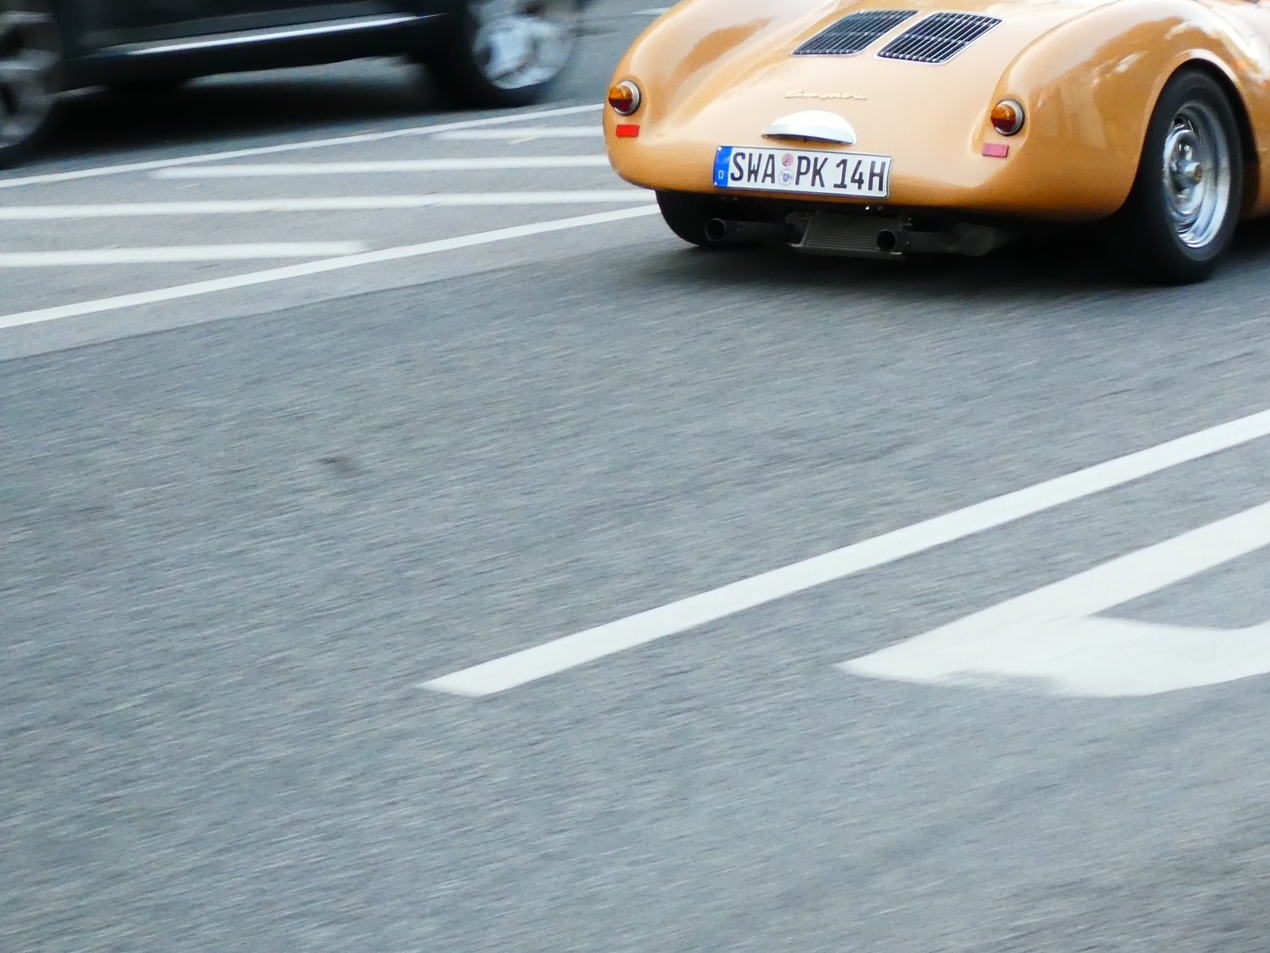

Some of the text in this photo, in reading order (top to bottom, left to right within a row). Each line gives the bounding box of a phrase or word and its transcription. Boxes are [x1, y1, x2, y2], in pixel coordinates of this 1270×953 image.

[730, 151, 776, 184] SWA
[794, 155, 829, 188] PK
[833, 158, 887, 192] 14H
